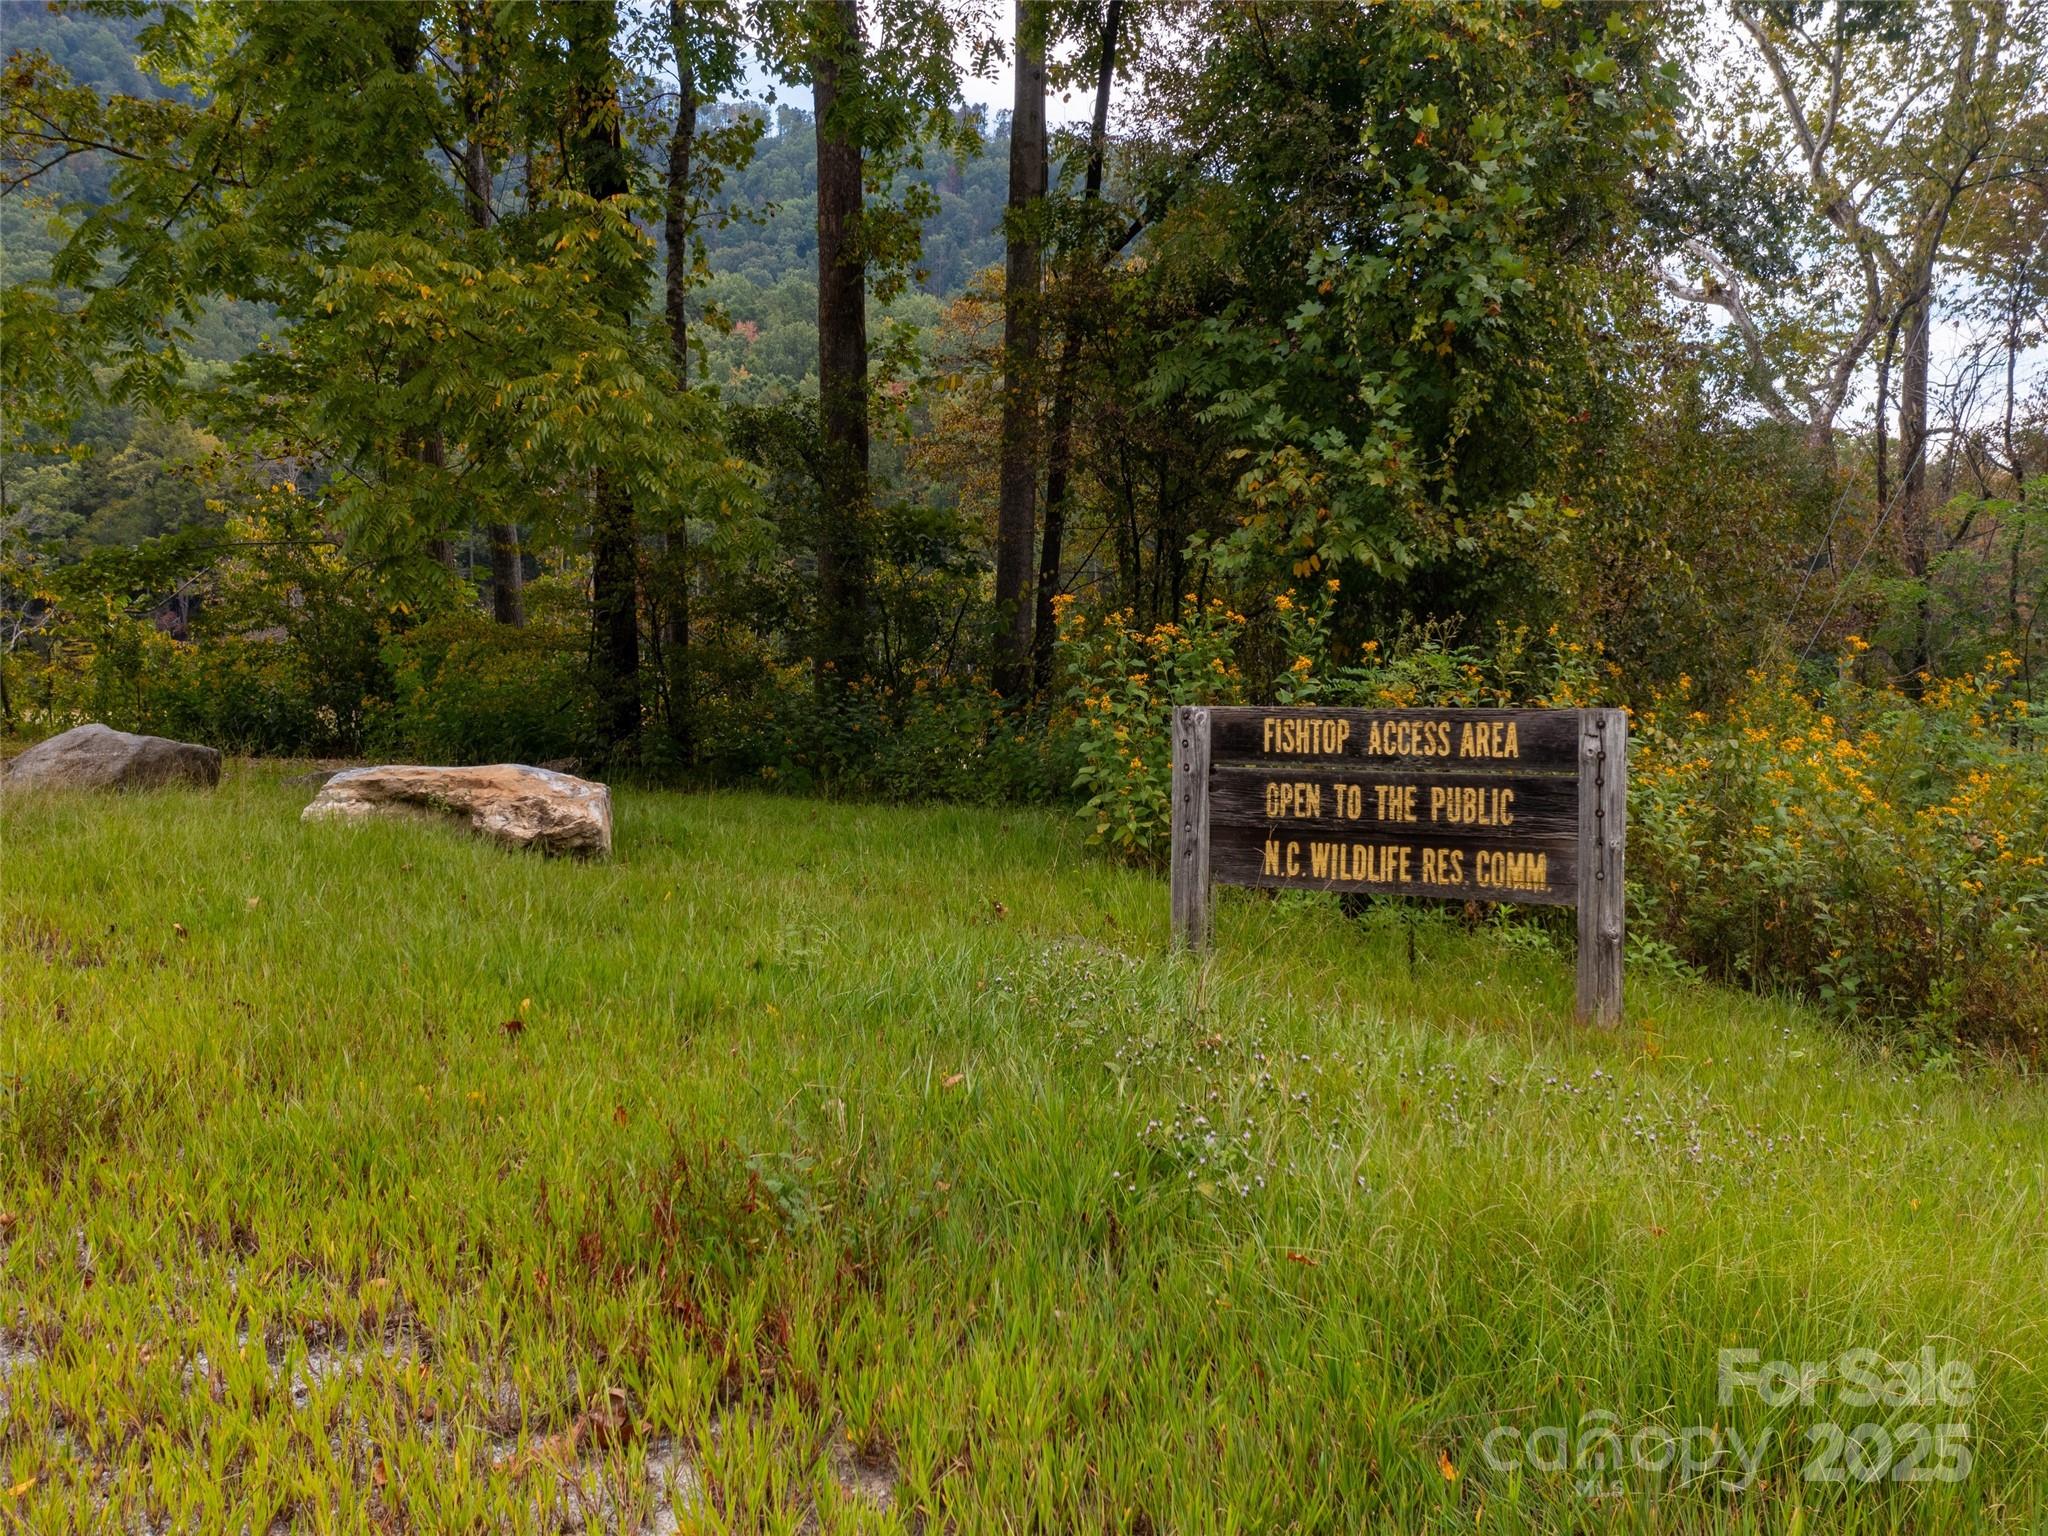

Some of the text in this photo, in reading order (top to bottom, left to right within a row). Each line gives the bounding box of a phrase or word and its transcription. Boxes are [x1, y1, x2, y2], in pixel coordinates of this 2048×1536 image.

[1263, 717, 1519, 758] FISHTOP ACCESS AREA
[1266, 782, 1515, 826] OPEN TO THE PUBLIC
[1264, 839, 1307, 877] N.C.
[1310, 841, 1412, 882] WILDLIFE
